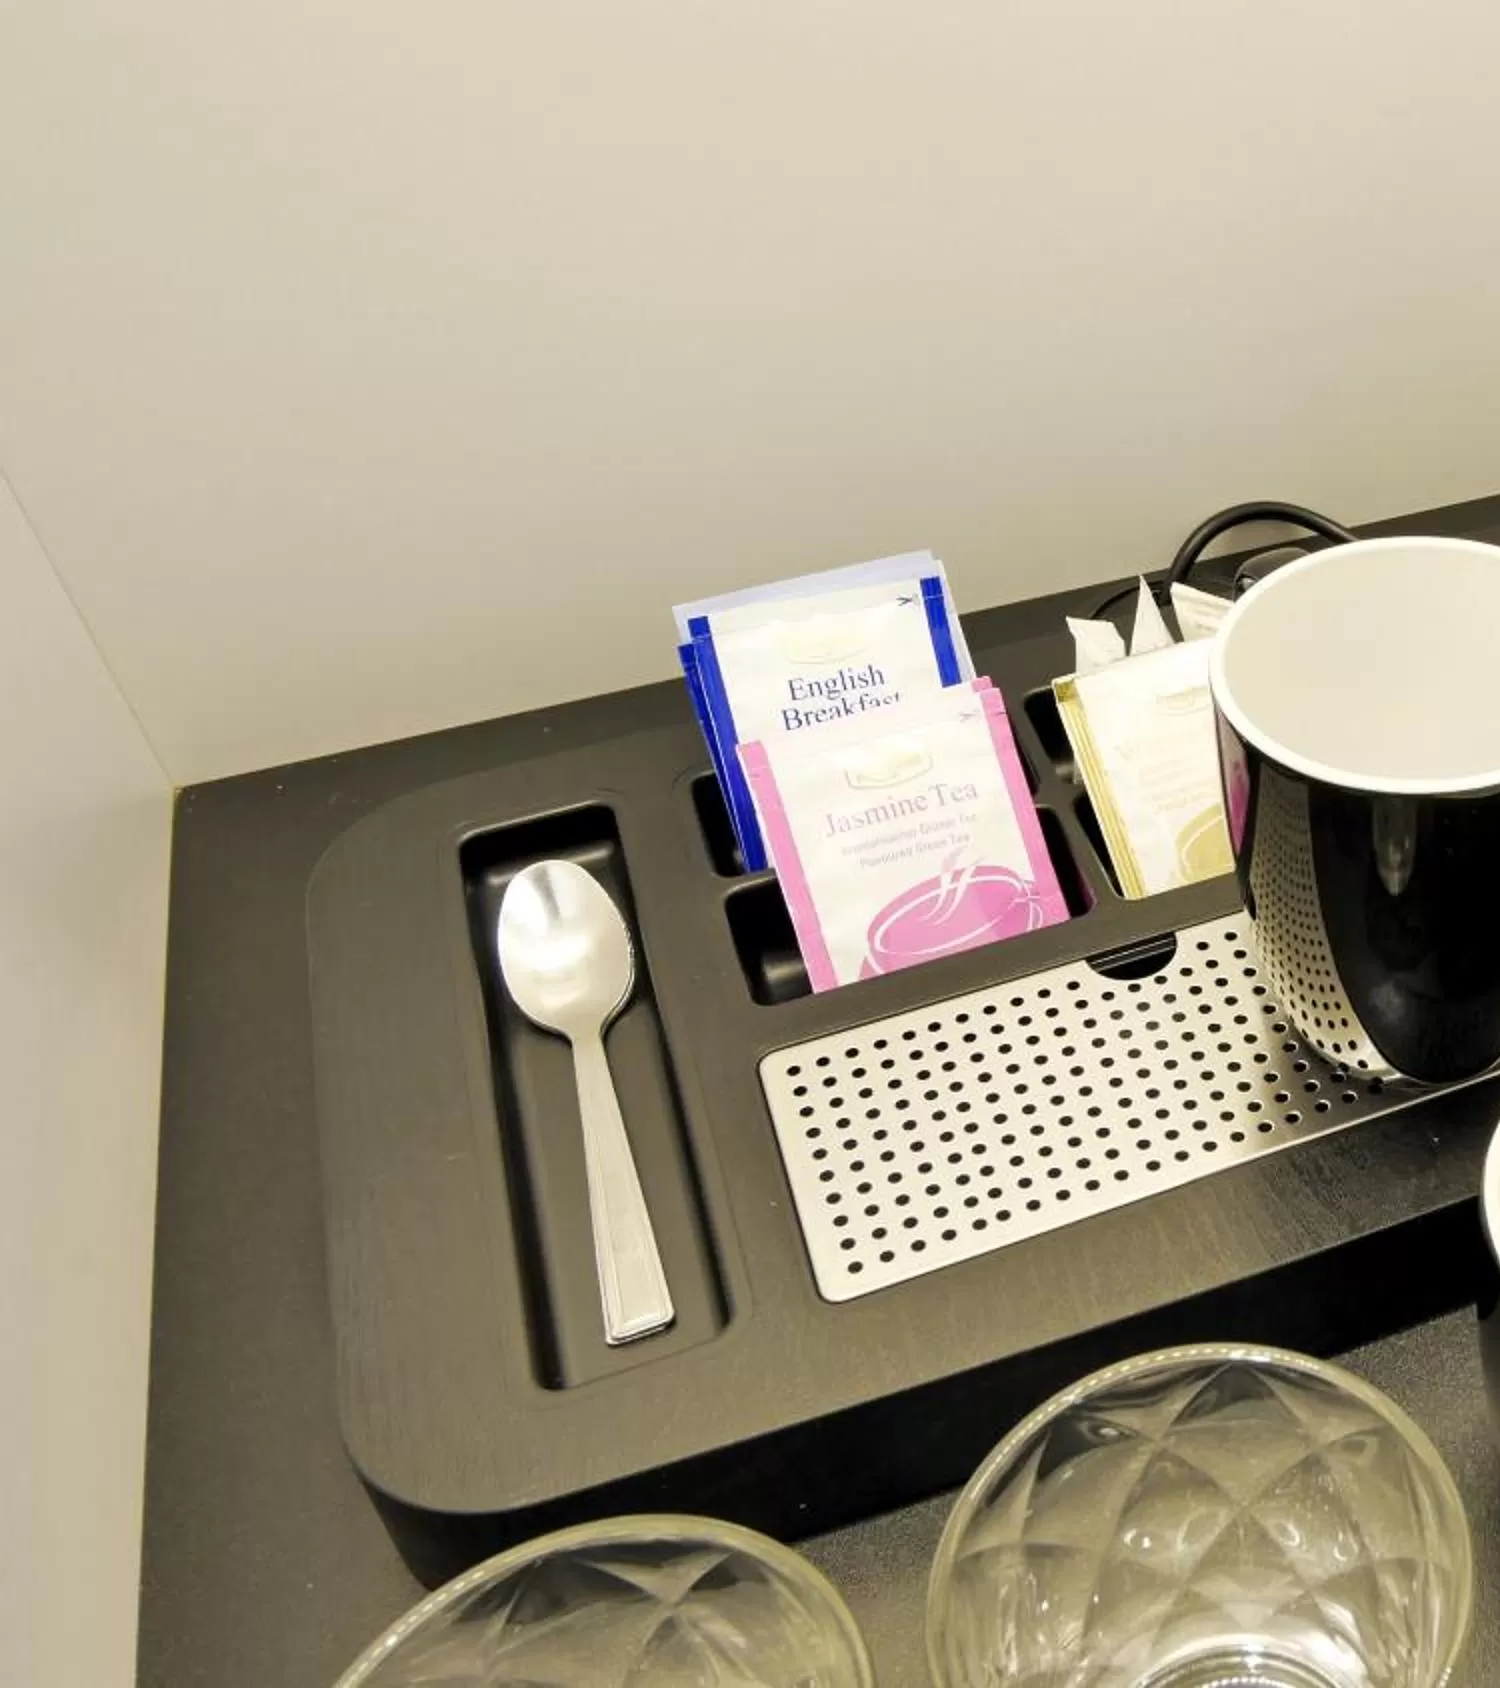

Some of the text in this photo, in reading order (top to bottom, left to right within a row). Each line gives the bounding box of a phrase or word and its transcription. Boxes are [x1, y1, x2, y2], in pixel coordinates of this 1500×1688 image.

[788, 664, 885, 701] English
[825, 794, 929, 838] Jasmine
[928, 783, 980, 807] Tea
